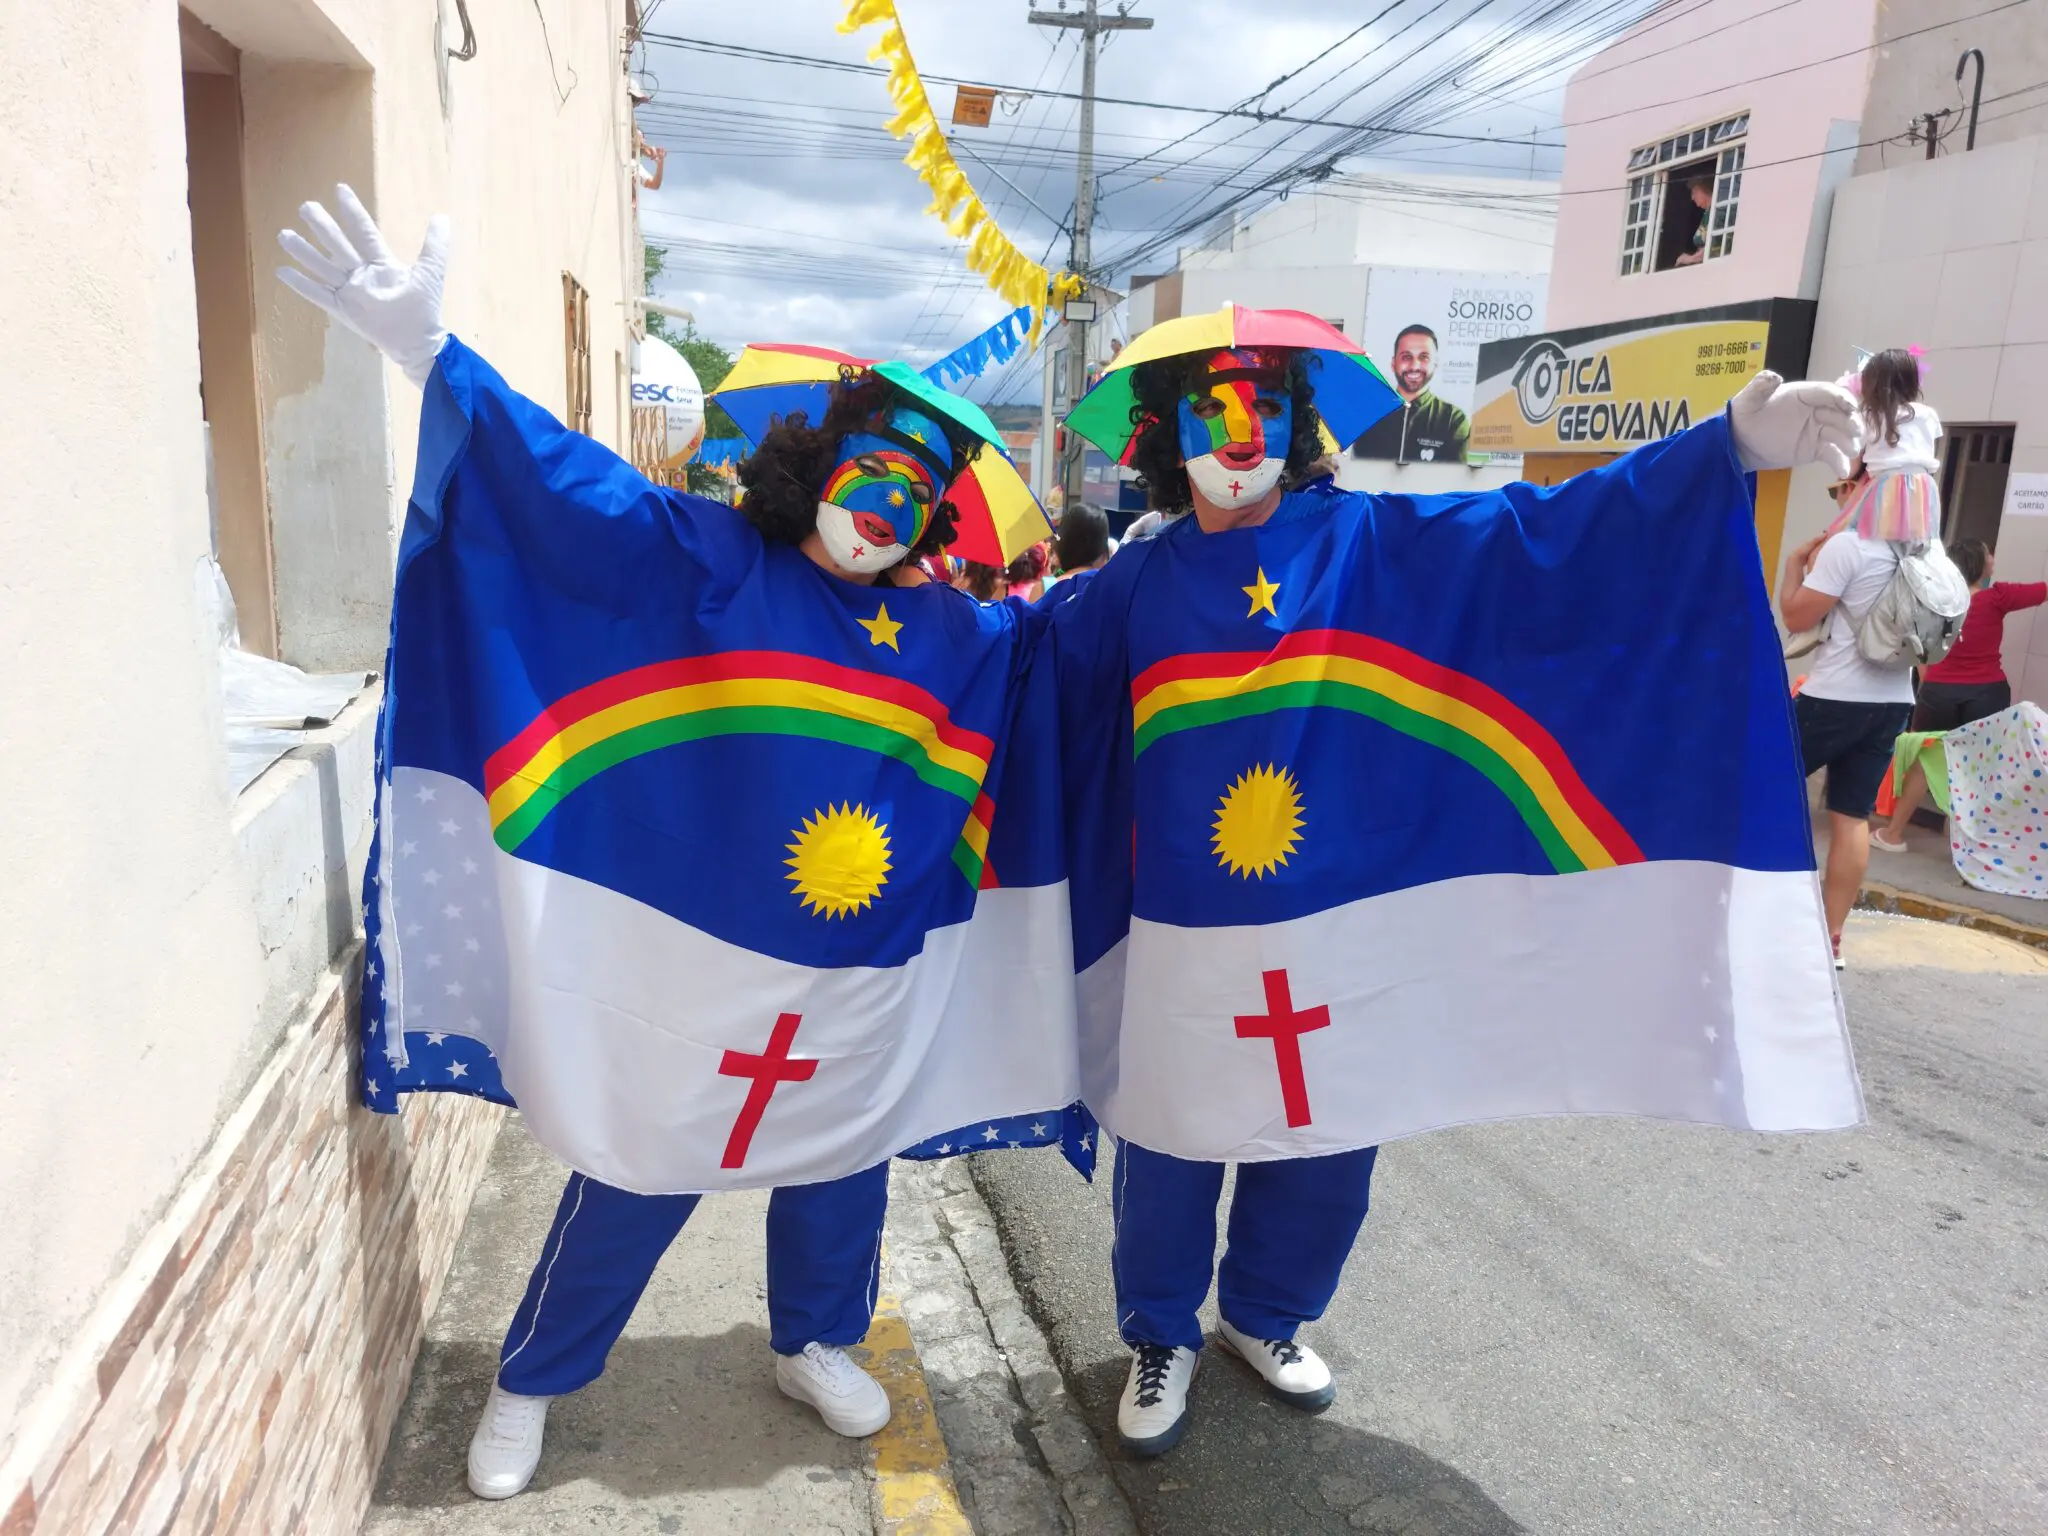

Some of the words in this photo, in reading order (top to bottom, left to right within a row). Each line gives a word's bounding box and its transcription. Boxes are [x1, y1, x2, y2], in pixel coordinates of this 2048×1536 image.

[1473, 290, 1509, 303] BUSCA
[1514, 291, 1533, 304] DO
[1447, 301, 1533, 321] SORRISO
[1697, 341, 1748, 358] 99810-6666
[1695, 360, 1746, 376] 98268-7000
[1557, 400, 1691, 441] GEOVANA
